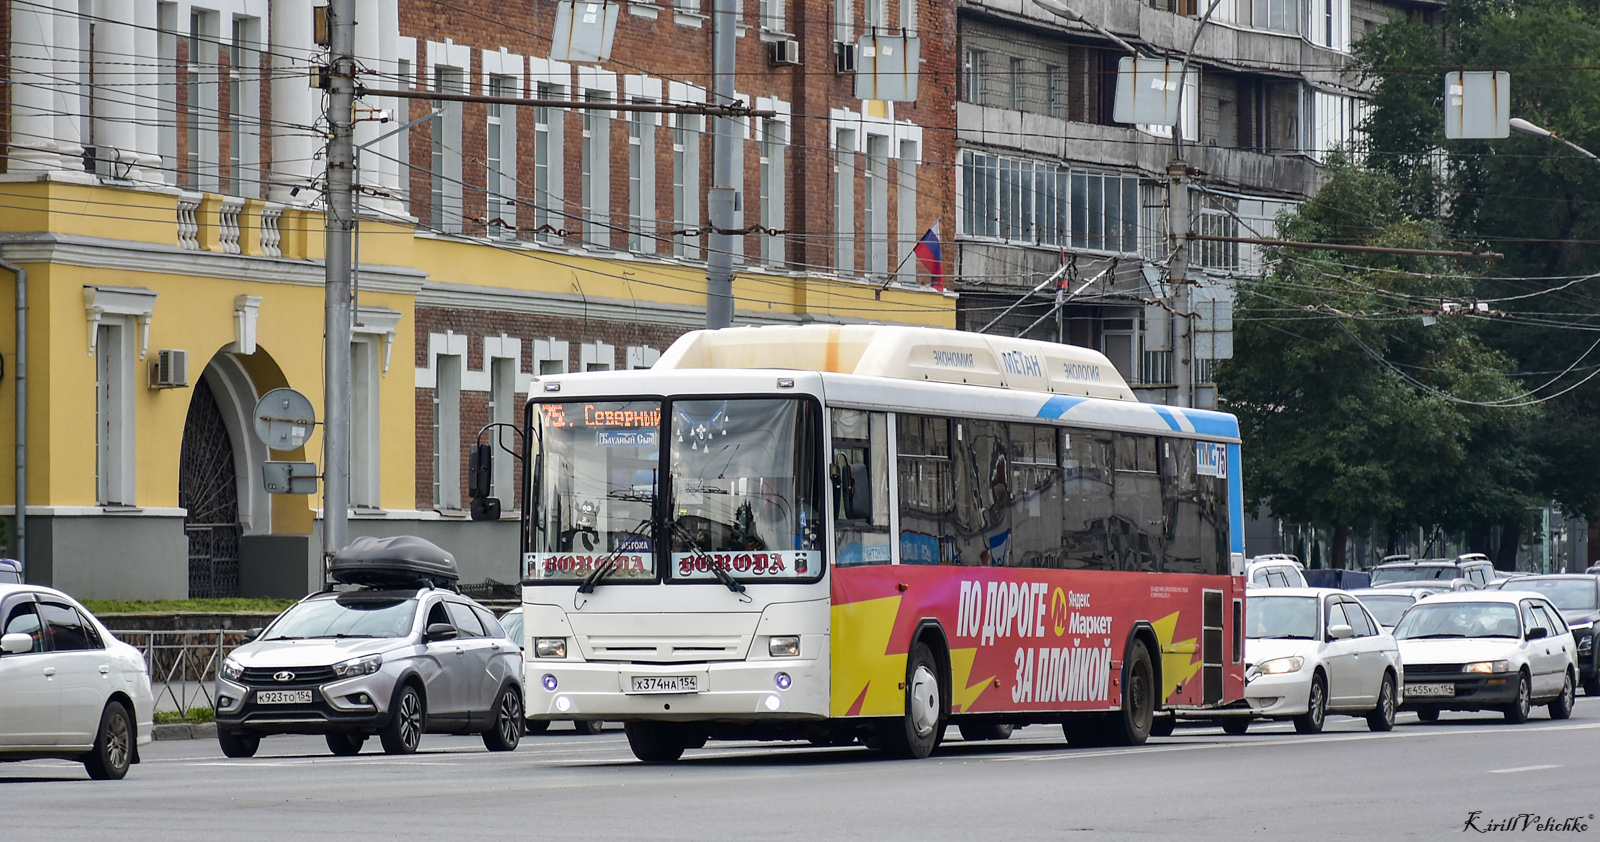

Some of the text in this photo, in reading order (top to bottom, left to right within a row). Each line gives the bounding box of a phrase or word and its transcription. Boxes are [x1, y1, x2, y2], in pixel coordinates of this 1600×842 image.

[933, 350, 975, 368] ЭКОНОМИЯ
[1001, 350, 1041, 377] МЕТАН
[1063, 362, 1101, 381] ЭКОЛОГИЯ
[585, 404, 661, 427] Северный
[1197, 442, 1226, 475] TMG 75
[1068, 590, 1091, 609] Яндекс
[956, 580, 1048, 646] ПО ДОРОГЕ
[1068, 612, 1112, 638] Маркет
[679, 677, 695, 687] 154
[1011, 638, 1112, 703] ЗА ПЛОЙКОЙ
[296, 691, 311, 700] 154
